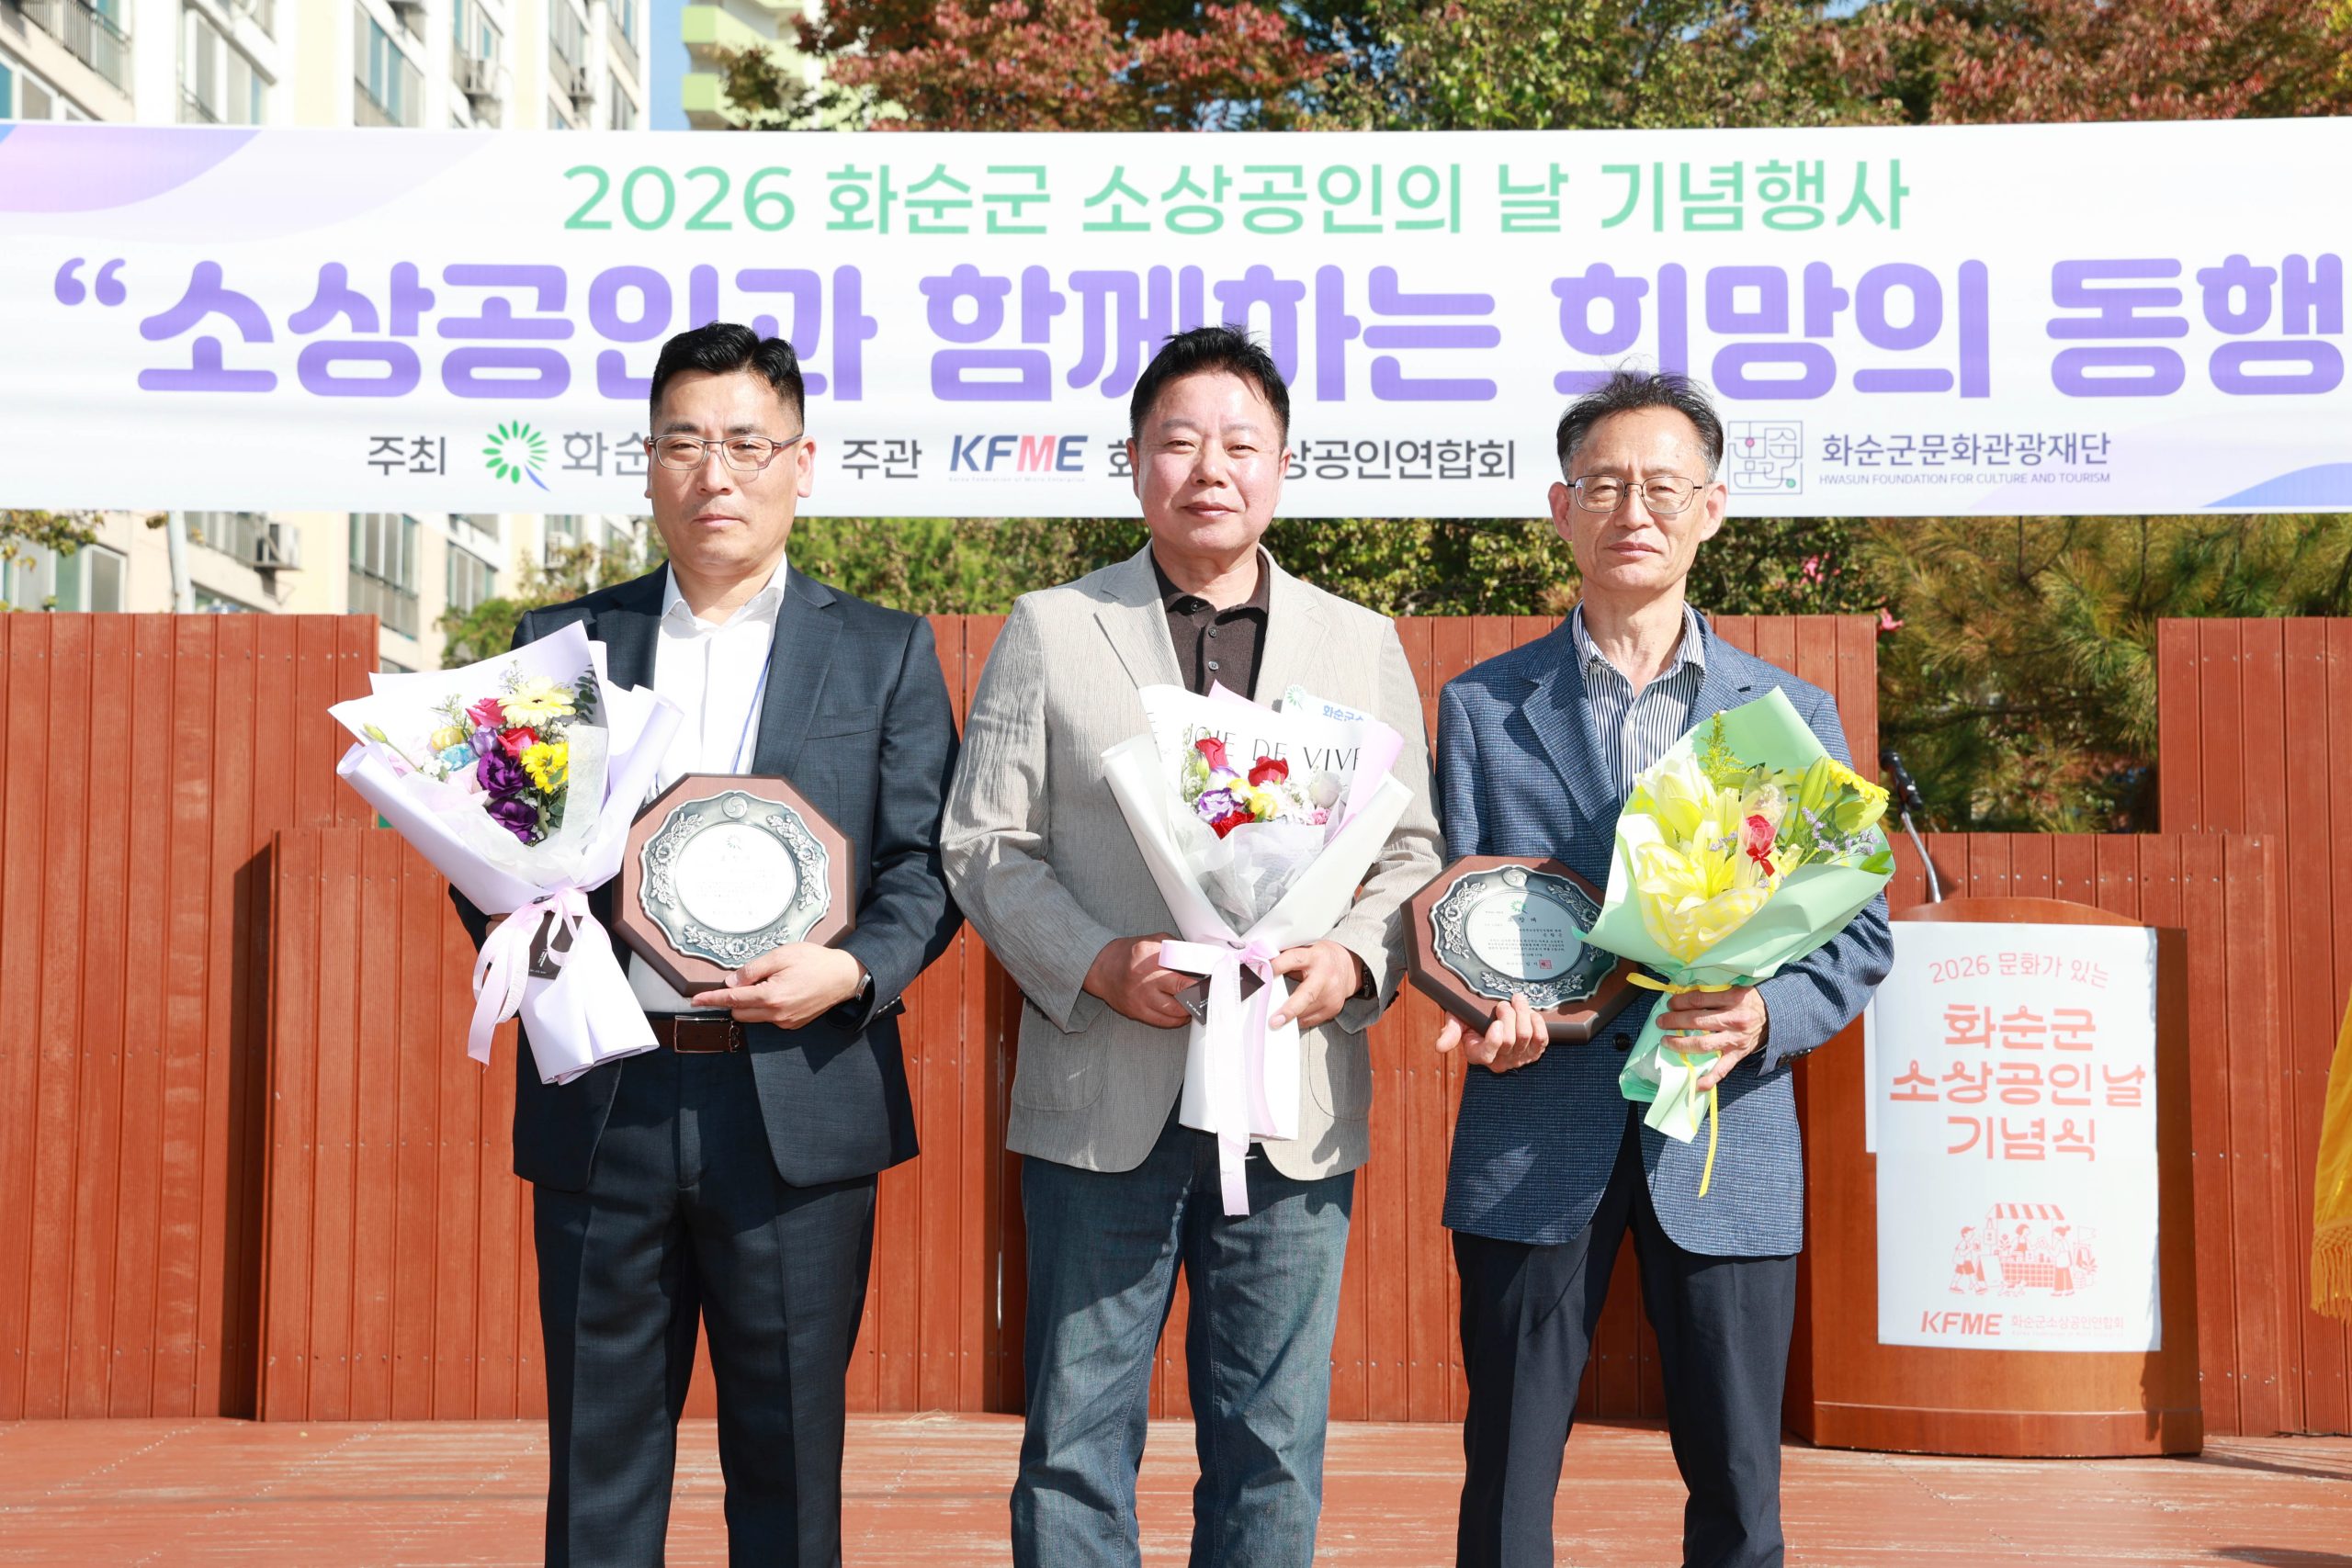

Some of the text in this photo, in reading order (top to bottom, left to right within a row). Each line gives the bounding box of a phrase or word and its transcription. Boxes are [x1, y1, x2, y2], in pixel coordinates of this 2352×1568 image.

[563, 159, 1910, 235] 2026 화순군 소상공인의 날 기념행사
[919, 263, 1501, 401] 함께하는
[1551, 259, 1990, 400] 희망의
[2046, 253, 2345, 397] 동행
[368, 432, 648, 476] 주최 화순
[842, 438, 922, 479] 주관
[950, 434, 1089, 471] KFME
[1823, 432, 2111, 466] 화순군문화관광재단
[1819, 472, 2111, 485] HWASUN FOUNDATION FOR CULTURE AND TOURISM
[1928, 952, 2109, 989] 2026 문화가 있는
[1943, 1003, 2097, 1052] 화순군
[1947, 1115, 2096, 1162] 기념식
[1921, 1310, 2003, 1336] KFME
